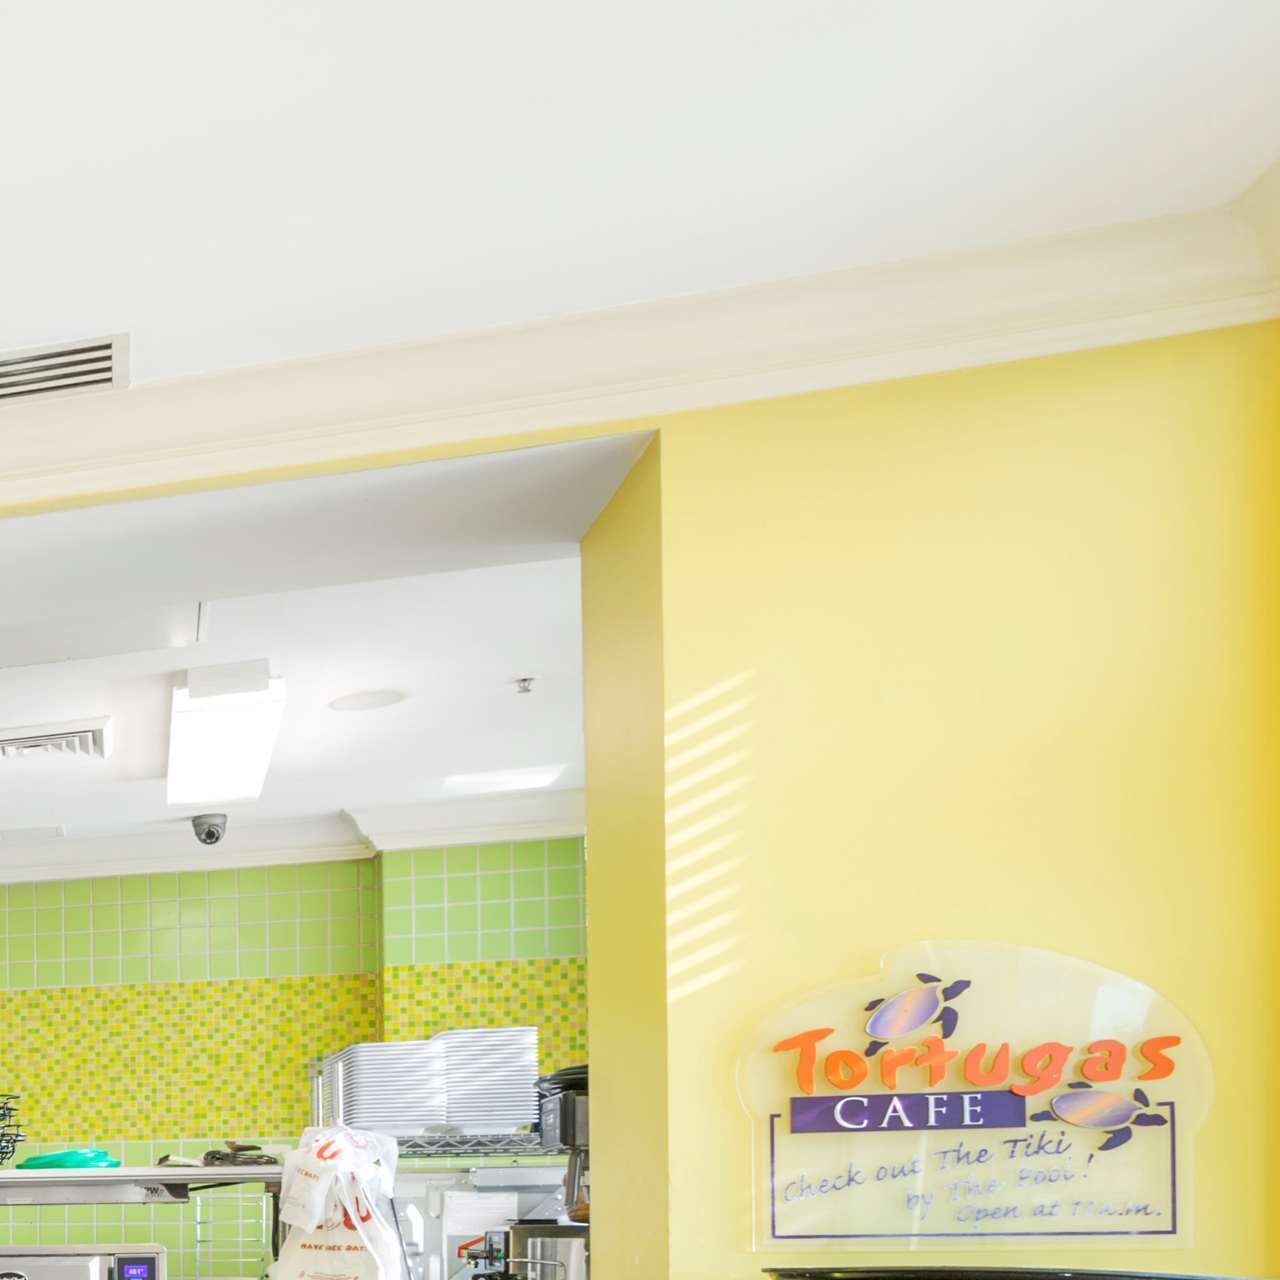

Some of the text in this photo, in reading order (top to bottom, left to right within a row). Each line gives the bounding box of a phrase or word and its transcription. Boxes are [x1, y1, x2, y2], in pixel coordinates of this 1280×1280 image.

[774, 1028, 1182, 1096] Tortugas
[833, 1093, 984, 1129] CAFE
[933, 1141, 992, 1170] The
